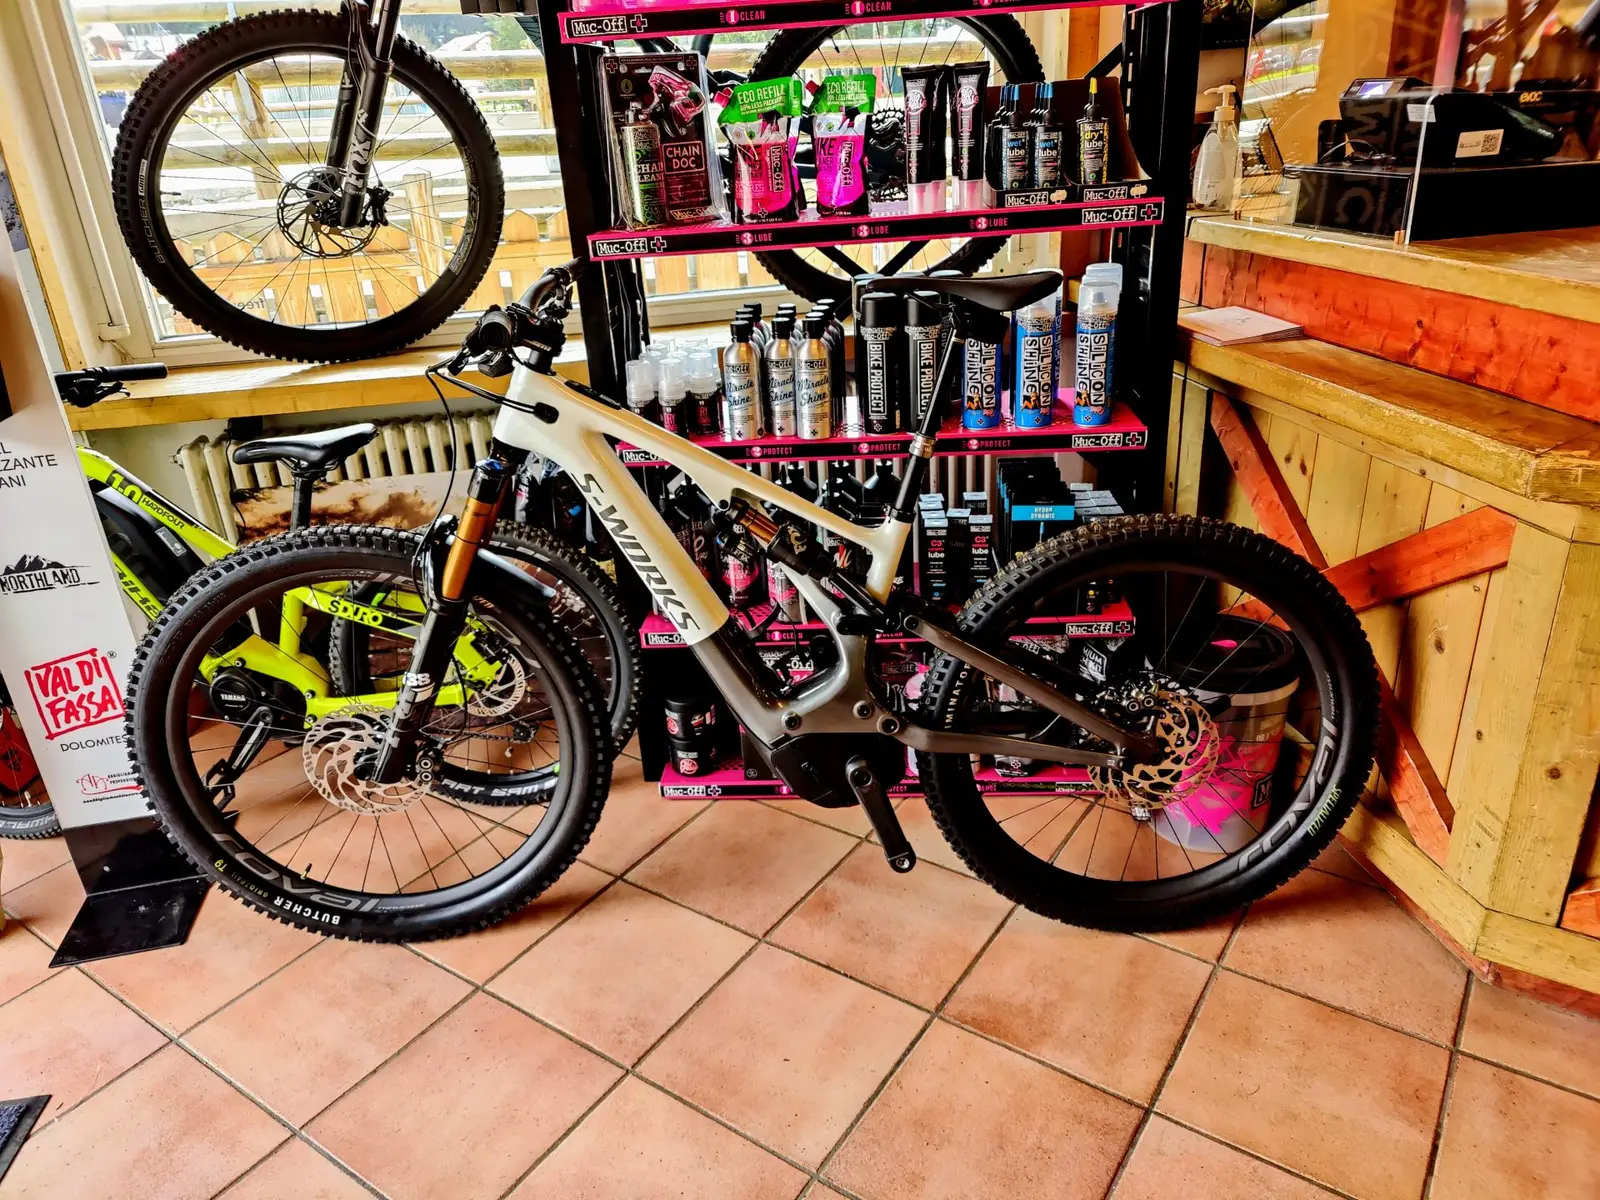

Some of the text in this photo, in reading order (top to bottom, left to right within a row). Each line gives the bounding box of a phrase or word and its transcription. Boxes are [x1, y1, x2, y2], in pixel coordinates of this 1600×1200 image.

[865, 1, 892, 12] CLEAN
[740, 10, 766, 21] CLEAN
[573, 18, 624, 35] Muc-Off
[737, 83, 786, 104] ECO REFILL
[827, 82, 840, 94] ECO
[1519, 91, 1543, 103] evoc
[1084, 130, 1099, 140] dry
[1084, 140, 1104, 148] lube
[666, 145, 700, 158] CHAIN
[1007, 148, 1025, 156] lube
[1039, 149, 1058, 157] lube
[672, 158, 696, 169] DOC
[772, 147, 784, 192] Muc-Off
[1007, 194, 1047, 206] Muc-Off
[1085, 188, 1126, 201] Muc-Off
[989, 217, 1008, 227] LUBE
[1085, 209, 1136, 223] Muc-Off
[870, 225, 889, 235] LUBE
[754, 232, 773, 242] LUBE
[598, 240, 645, 254] Muc-Off
[920, 342, 933, 367] BIKE
[797, 376, 829, 391] Miracle
[869, 344, 884, 413] BIKE PROTECT
[727, 394, 750, 407] Shine
[768, 390, 794, 403] Shine
[800, 392, 827, 406] Shine
[870, 443, 901, 451] PROTECT
[980, 439, 1011, 448] PROTECT
[1073, 435, 1121, 447] Muc-Off
[762, 446, 793, 455] PROTECT
[141, 497, 186, 530] HARDFOUR
[570, 472, 701, 631] S-WORKS
[971, 547, 989, 555] lube
[0, 567, 81, 592] NORTHLAND
[35, 665, 80, 697] VAL
[220, 693, 246, 702] YAMAHA
[45, 685, 118, 729] FASSA
[665, 786, 705, 796] Muc-Off
[1307, 783, 1343, 838] SPECIALIZED
[273, 894, 342, 926] BUTCHER
